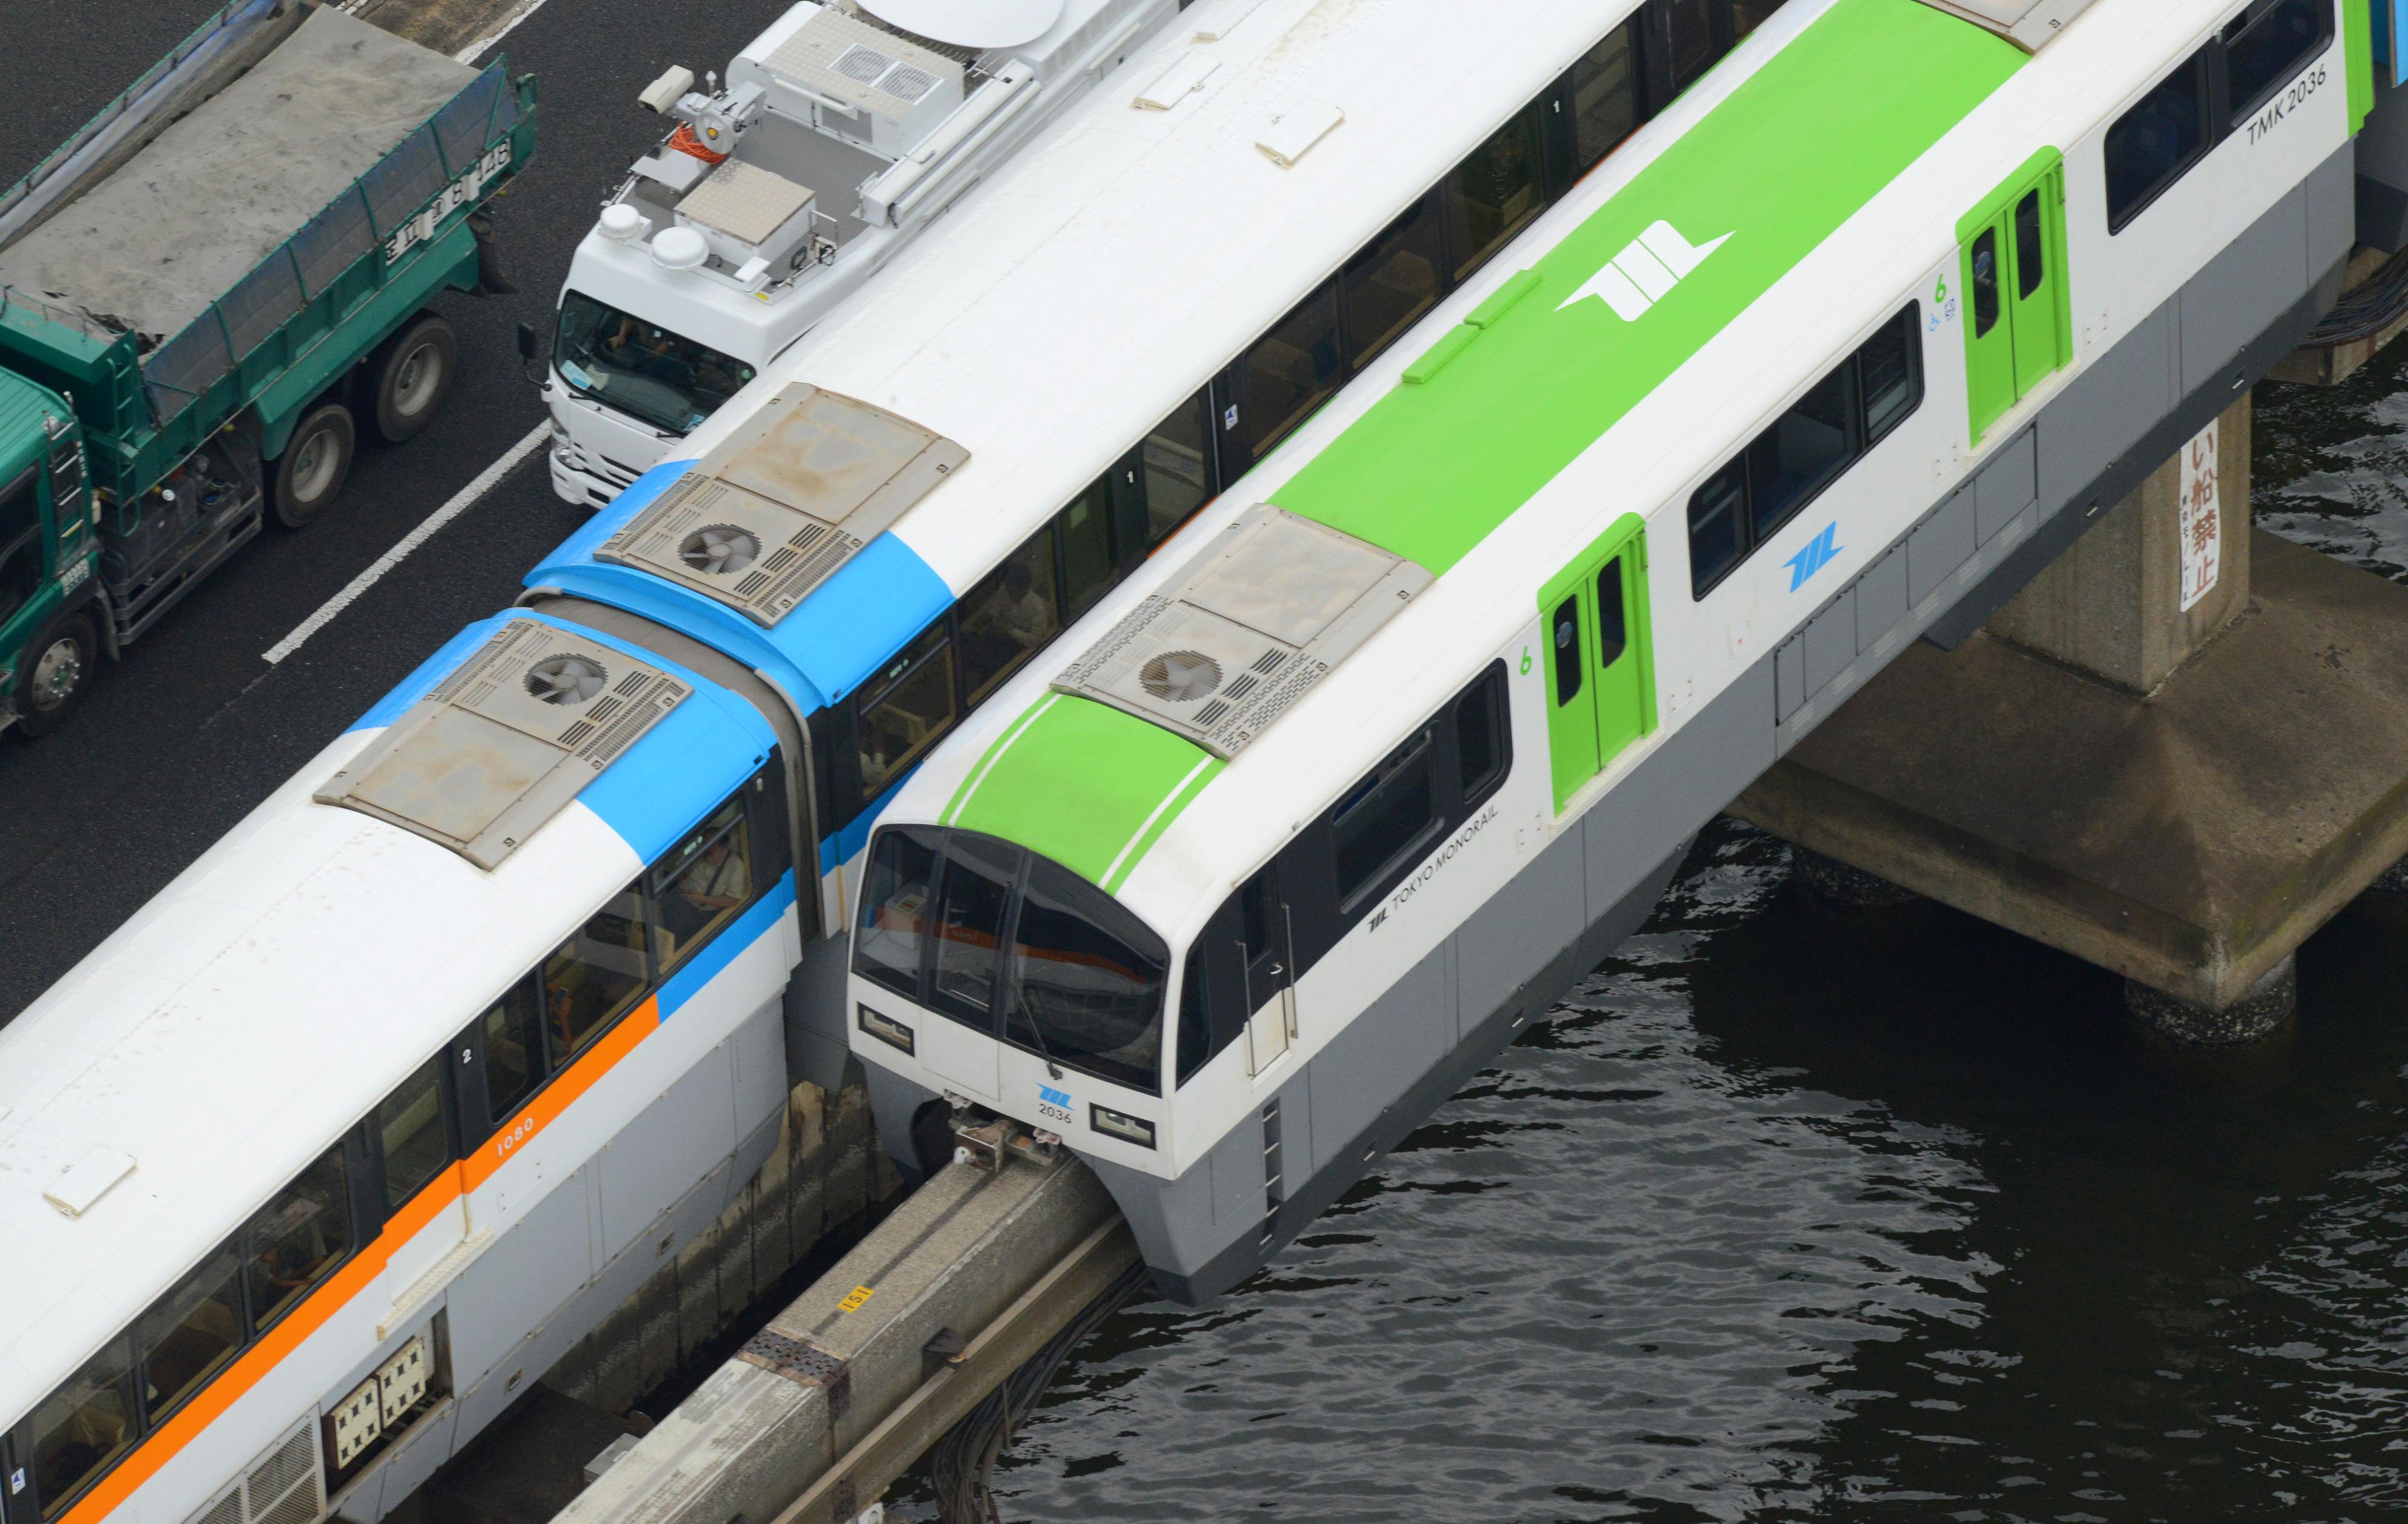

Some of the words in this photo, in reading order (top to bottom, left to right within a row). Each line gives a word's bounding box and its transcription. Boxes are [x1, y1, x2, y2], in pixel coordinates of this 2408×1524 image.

[1553, 100, 1560, 113] 1
[2247, 98, 2284, 146] TMK
[2287, 63, 2326, 113] 2036
[1935, 273, 1947, 303] 6
[1126, 470, 1134, 483] 1
[1520, 645, 1533, 676] 6
[1392, 865, 1433, 909] TOKYO
[1435, 805, 1498, 872] MONORAIL
[462, 1048, 472, 1064] 2
[1039, 1103, 1072, 1124] 2036
[497, 1118, 534, 1156] 1080
[842, 1289, 870, 1309] 151
